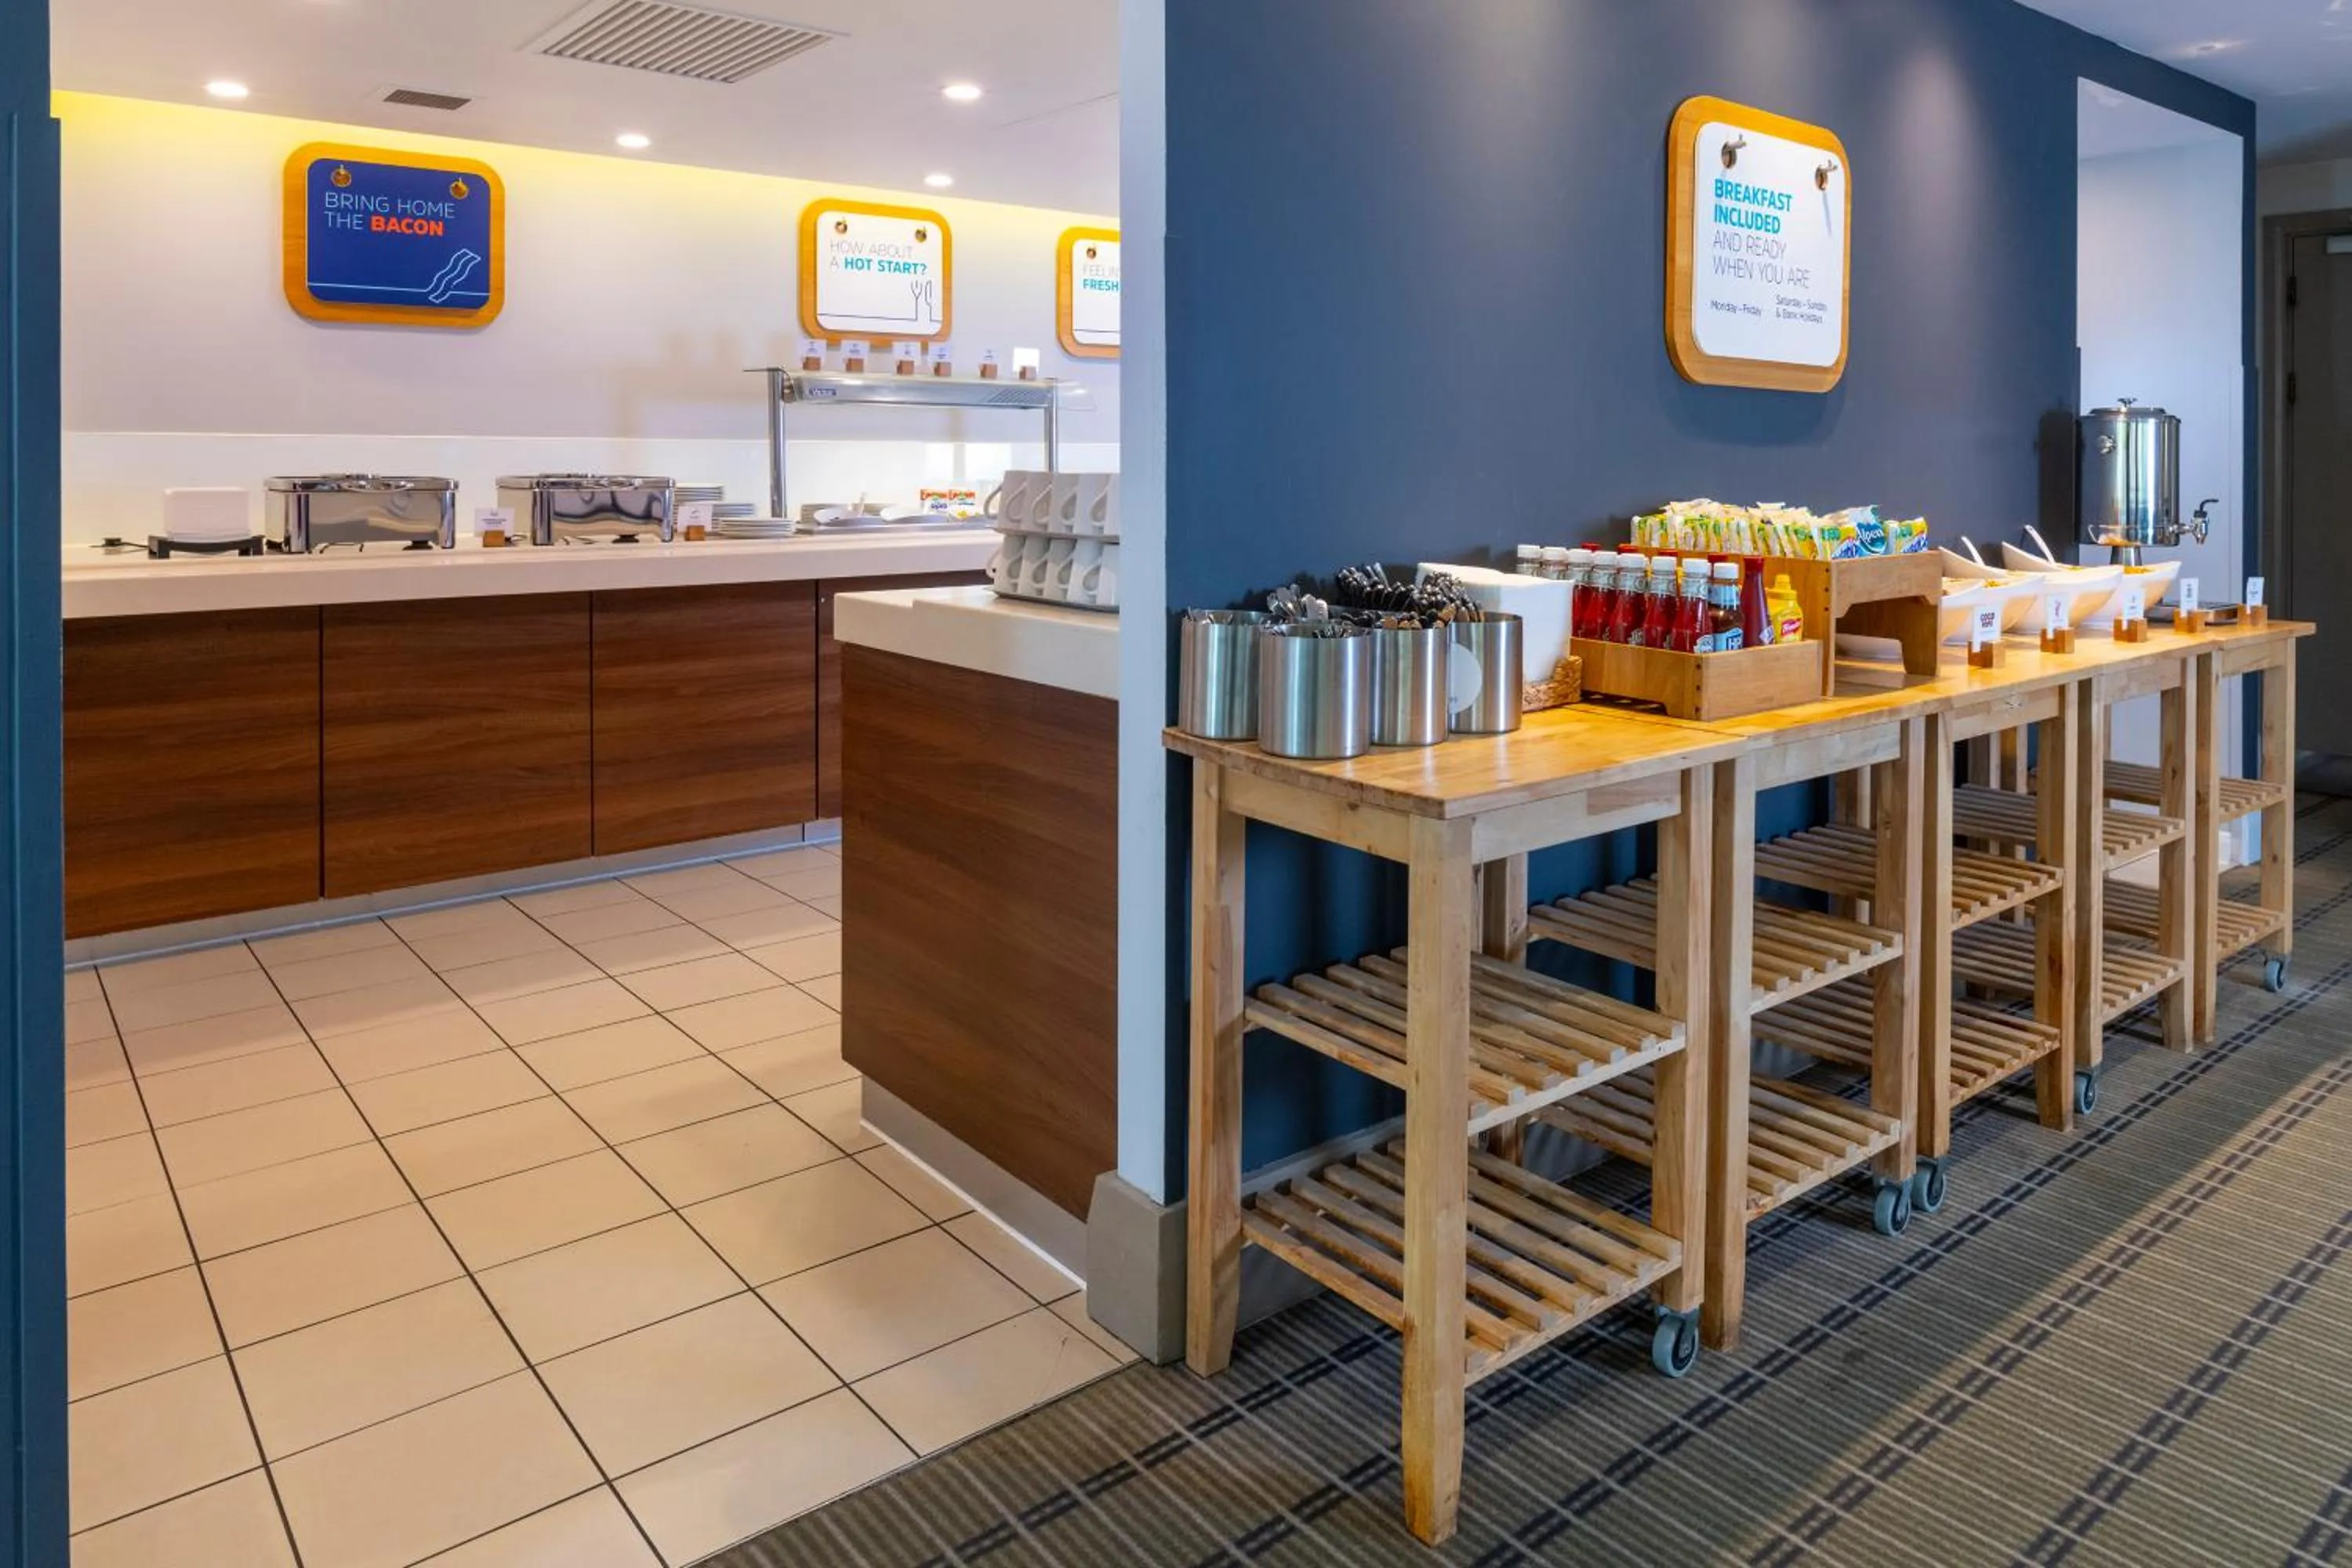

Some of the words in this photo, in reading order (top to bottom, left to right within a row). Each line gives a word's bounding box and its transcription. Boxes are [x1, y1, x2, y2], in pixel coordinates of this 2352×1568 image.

[325, 191, 390, 213] BRING
[397, 198, 456, 219] HOME
[1715, 178, 1793, 212] BREAKFAST
[324, 210, 364, 230] THE
[371, 215, 445, 237] BACON
[1714, 204, 1780, 234] INCLUDED
[830, 240, 864, 255] HOW
[869, 242, 913, 259] ABOUT
[1714, 230, 1742, 252] AND
[1746, 234, 1787, 260] READY
[830, 256, 840, 269] A
[844, 256, 873, 271] HOT
[877, 260, 928, 276] START?
[1713, 256, 1754, 279] WHEN
[1757, 261, 1784, 285] YOU
[1787, 267, 1810, 289] ARE
[1083, 278, 1119, 292] FRESH
[1710, 299, 1737, 314] Monday
